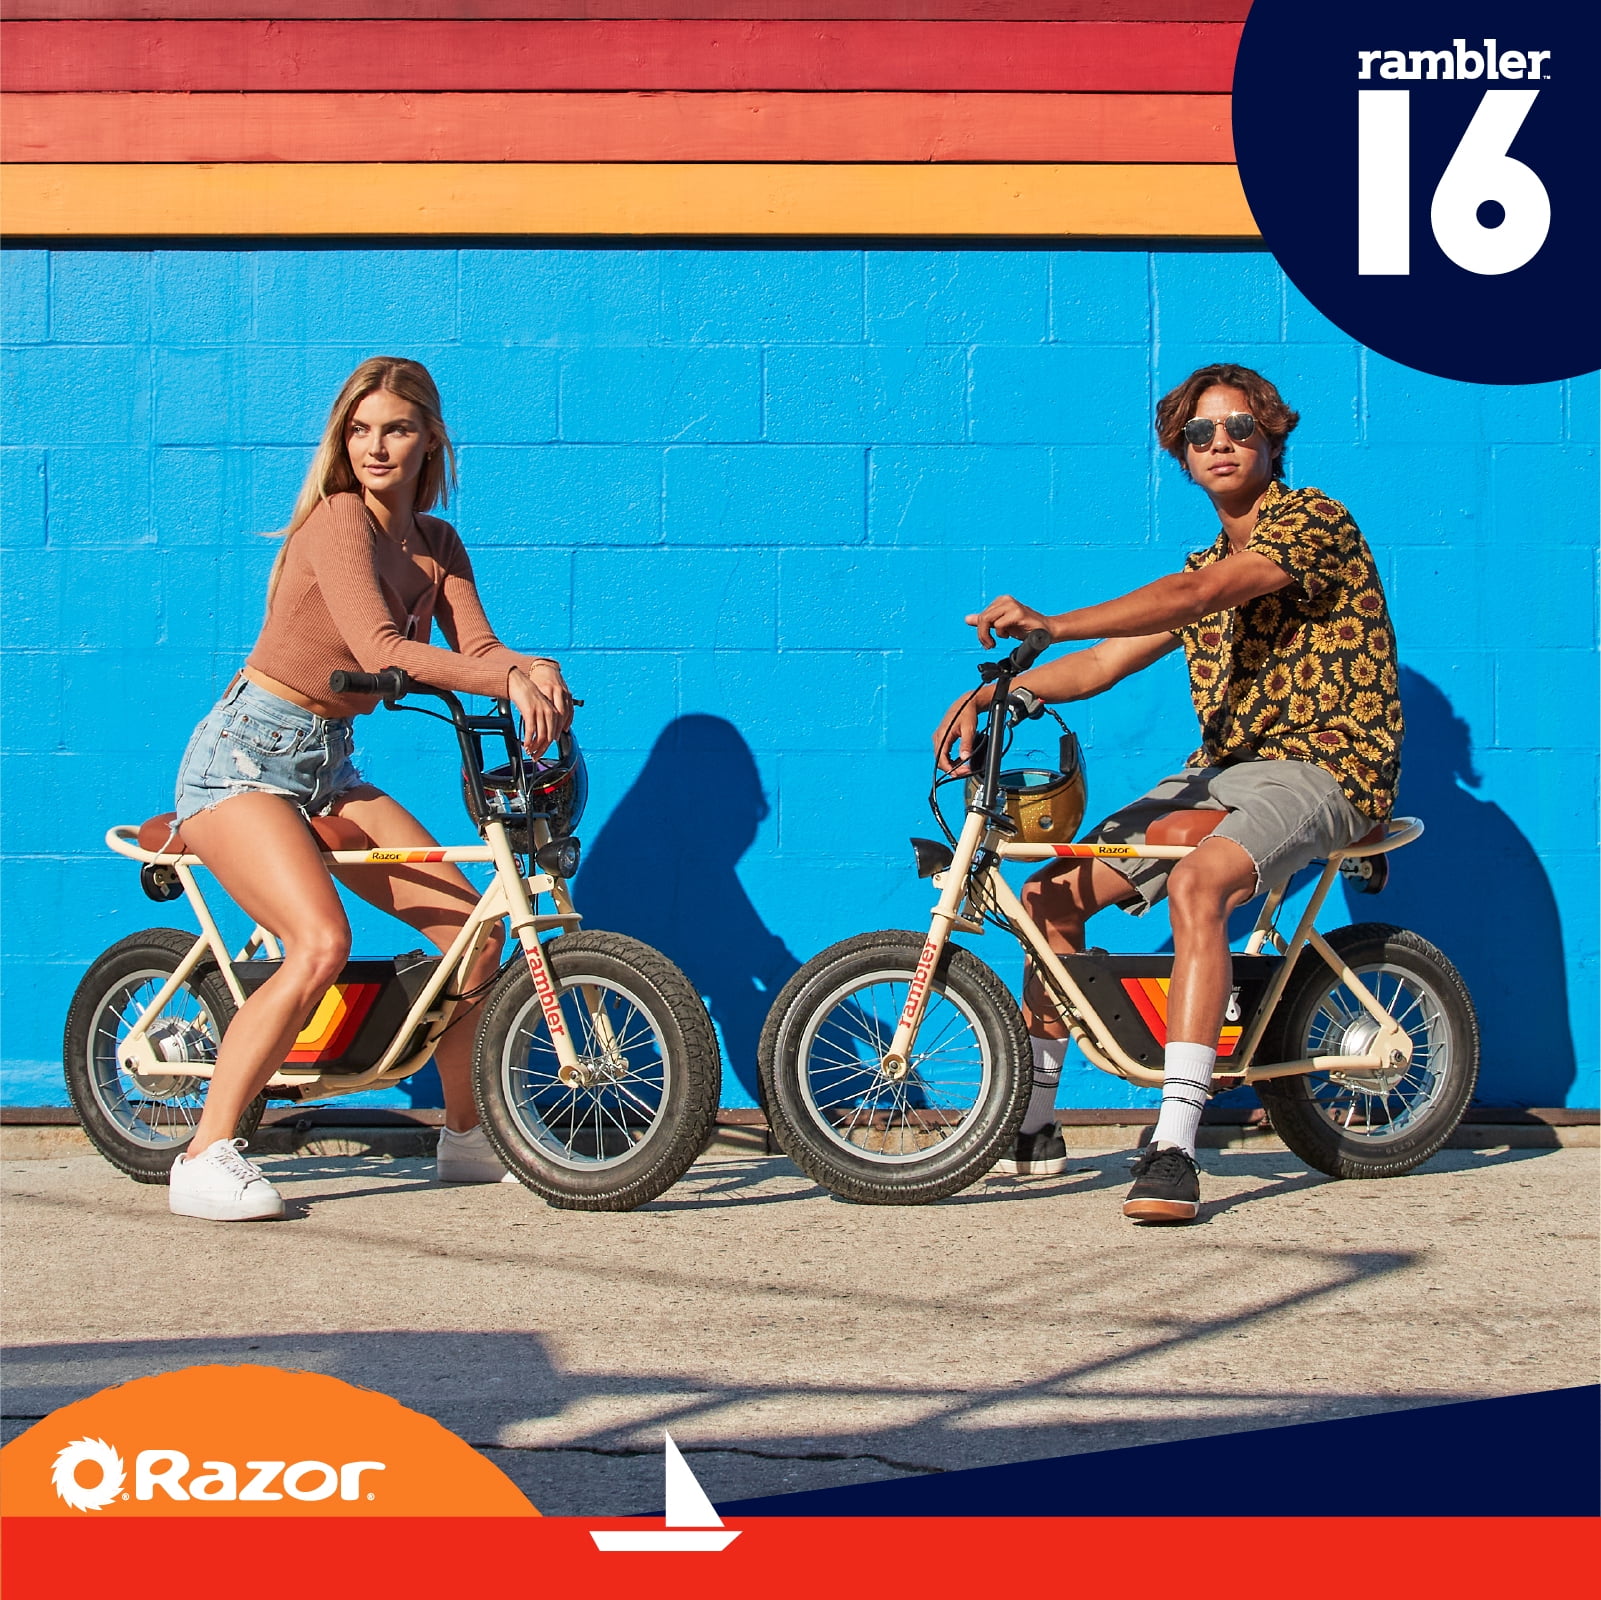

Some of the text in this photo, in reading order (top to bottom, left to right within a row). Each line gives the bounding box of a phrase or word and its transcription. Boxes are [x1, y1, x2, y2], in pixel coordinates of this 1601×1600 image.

[372, 852, 401, 861] Razor
[1099, 846, 1130, 854] Razor
[525, 945, 565, 1036] rambler
[899, 937, 937, 1029] rambler
